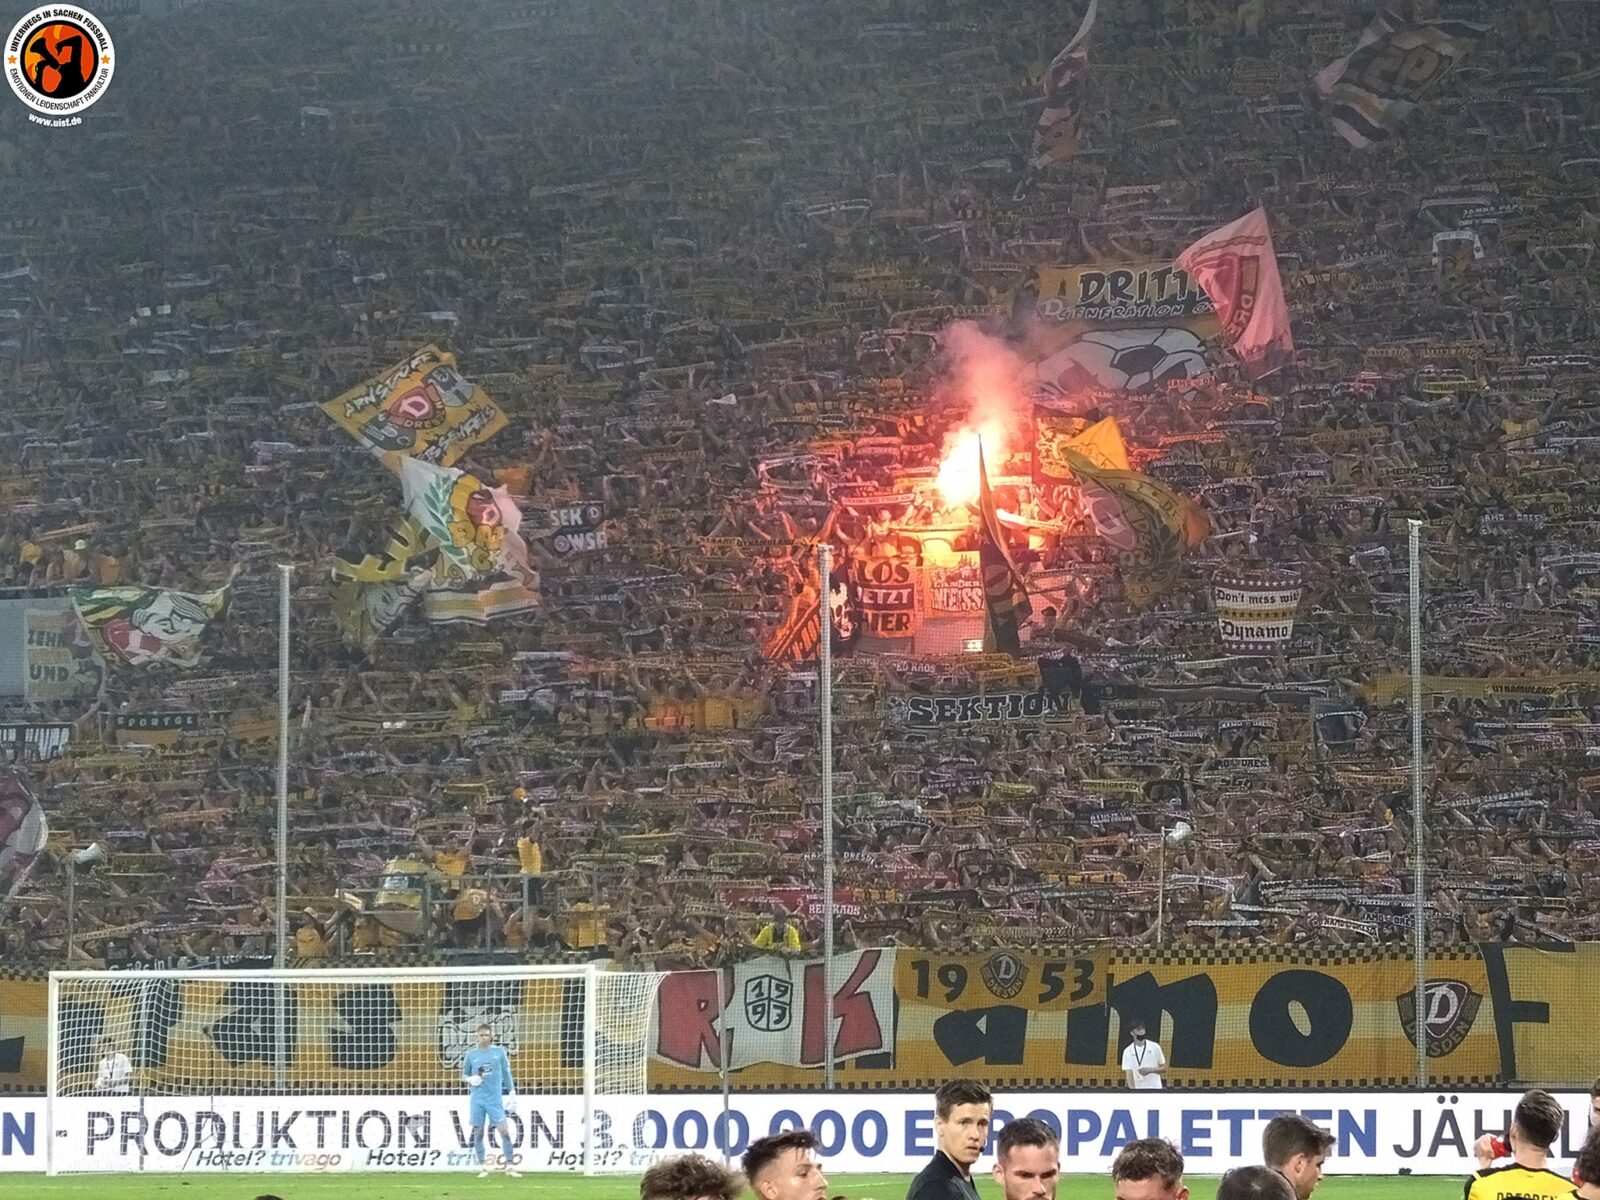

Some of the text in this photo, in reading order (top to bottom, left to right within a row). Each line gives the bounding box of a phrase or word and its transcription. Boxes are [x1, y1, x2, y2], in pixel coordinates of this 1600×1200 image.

[856, 561, 910, 584] LOS
[855, 587, 912, 604] JETZT
[1215, 589, 1245, 602] Don't
[1279, 591, 1300, 602] wit
[1221, 619, 1289, 640] Dynamo
[29, 665, 70, 682] UND
[907, 691, 1073, 722] SEKTION
[911, 959, 1095, 1003] 19 53
[86, 1110, 432, 1157] PRODUKTION
[196, 1149, 342, 1170] Hotel? trivago
[365, 1149, 441, 1167] Hotel?
